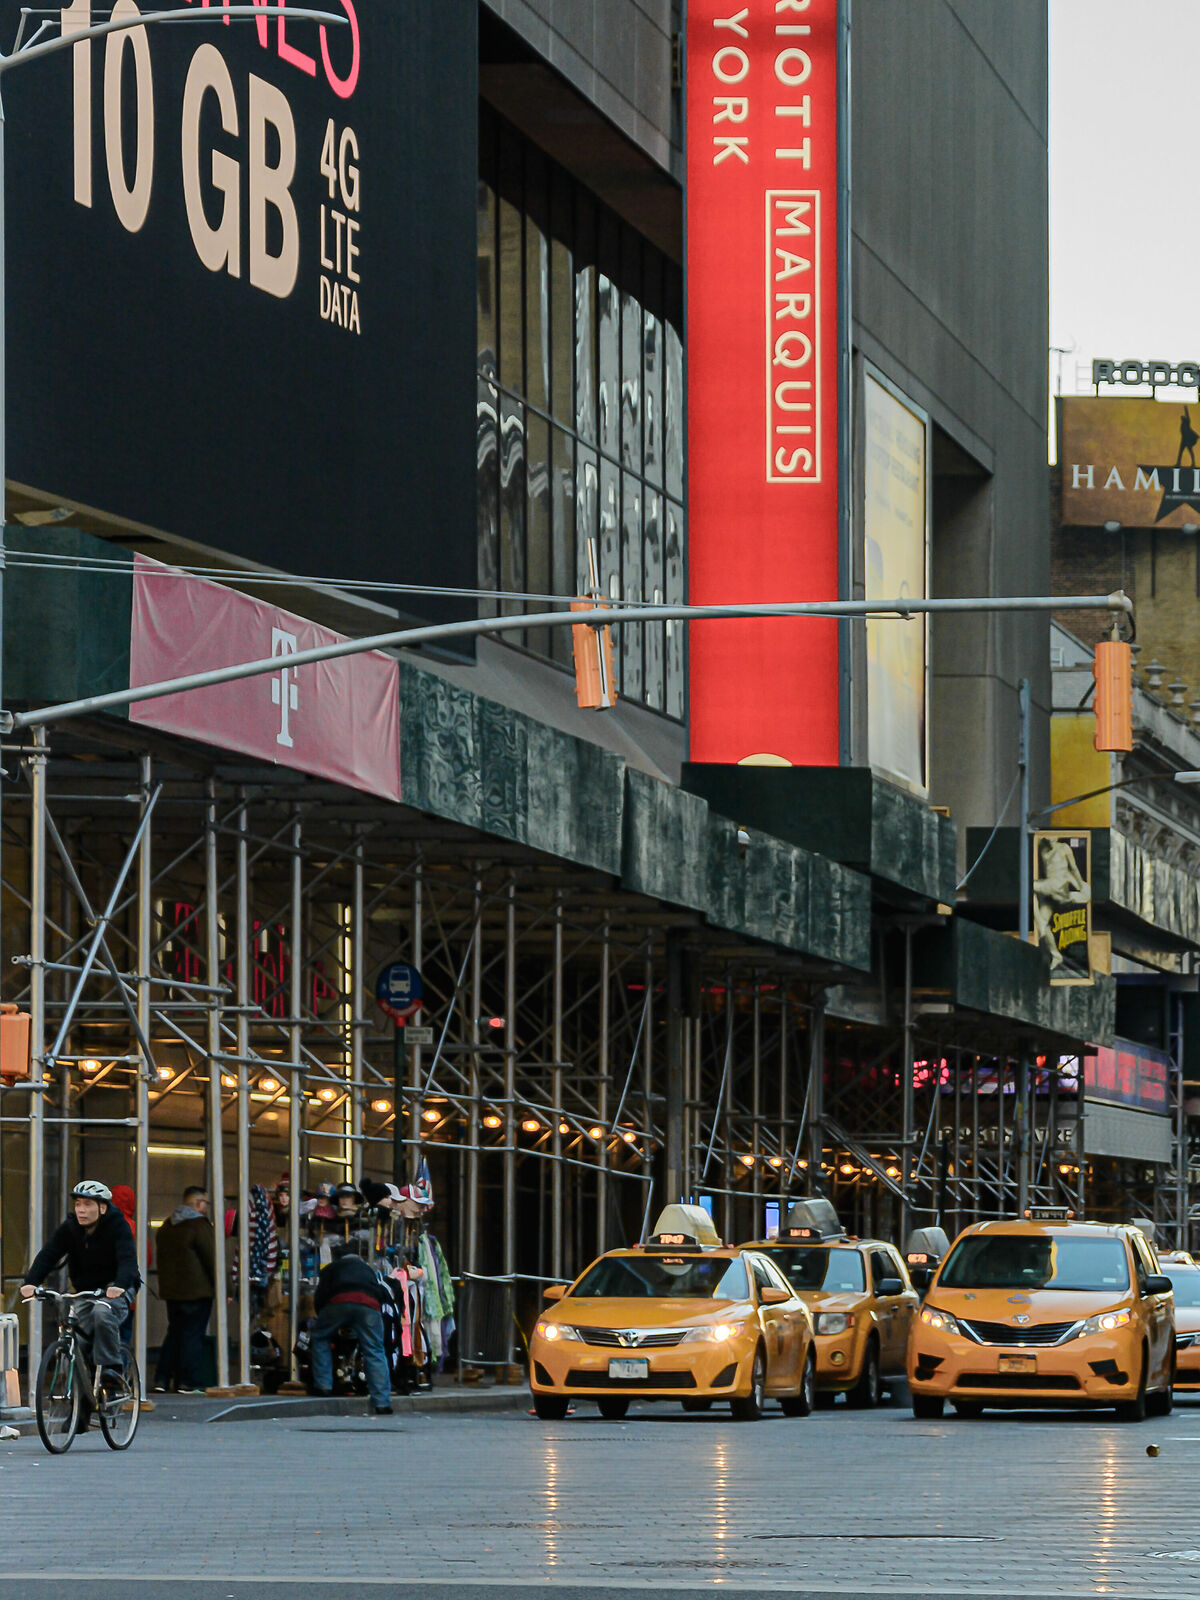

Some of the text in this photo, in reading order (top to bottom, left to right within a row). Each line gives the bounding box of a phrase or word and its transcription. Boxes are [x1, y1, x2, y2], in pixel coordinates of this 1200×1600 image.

[61, 0, 154, 233] 10
[181, 43, 300, 298] GB
[712, 8, 750, 165] YORK
[320, 118, 360, 213] 4G
[320, 203, 360, 284] LTE
[320, 275, 361, 336] DATA
[772, 200, 812, 474] MARQUIS
